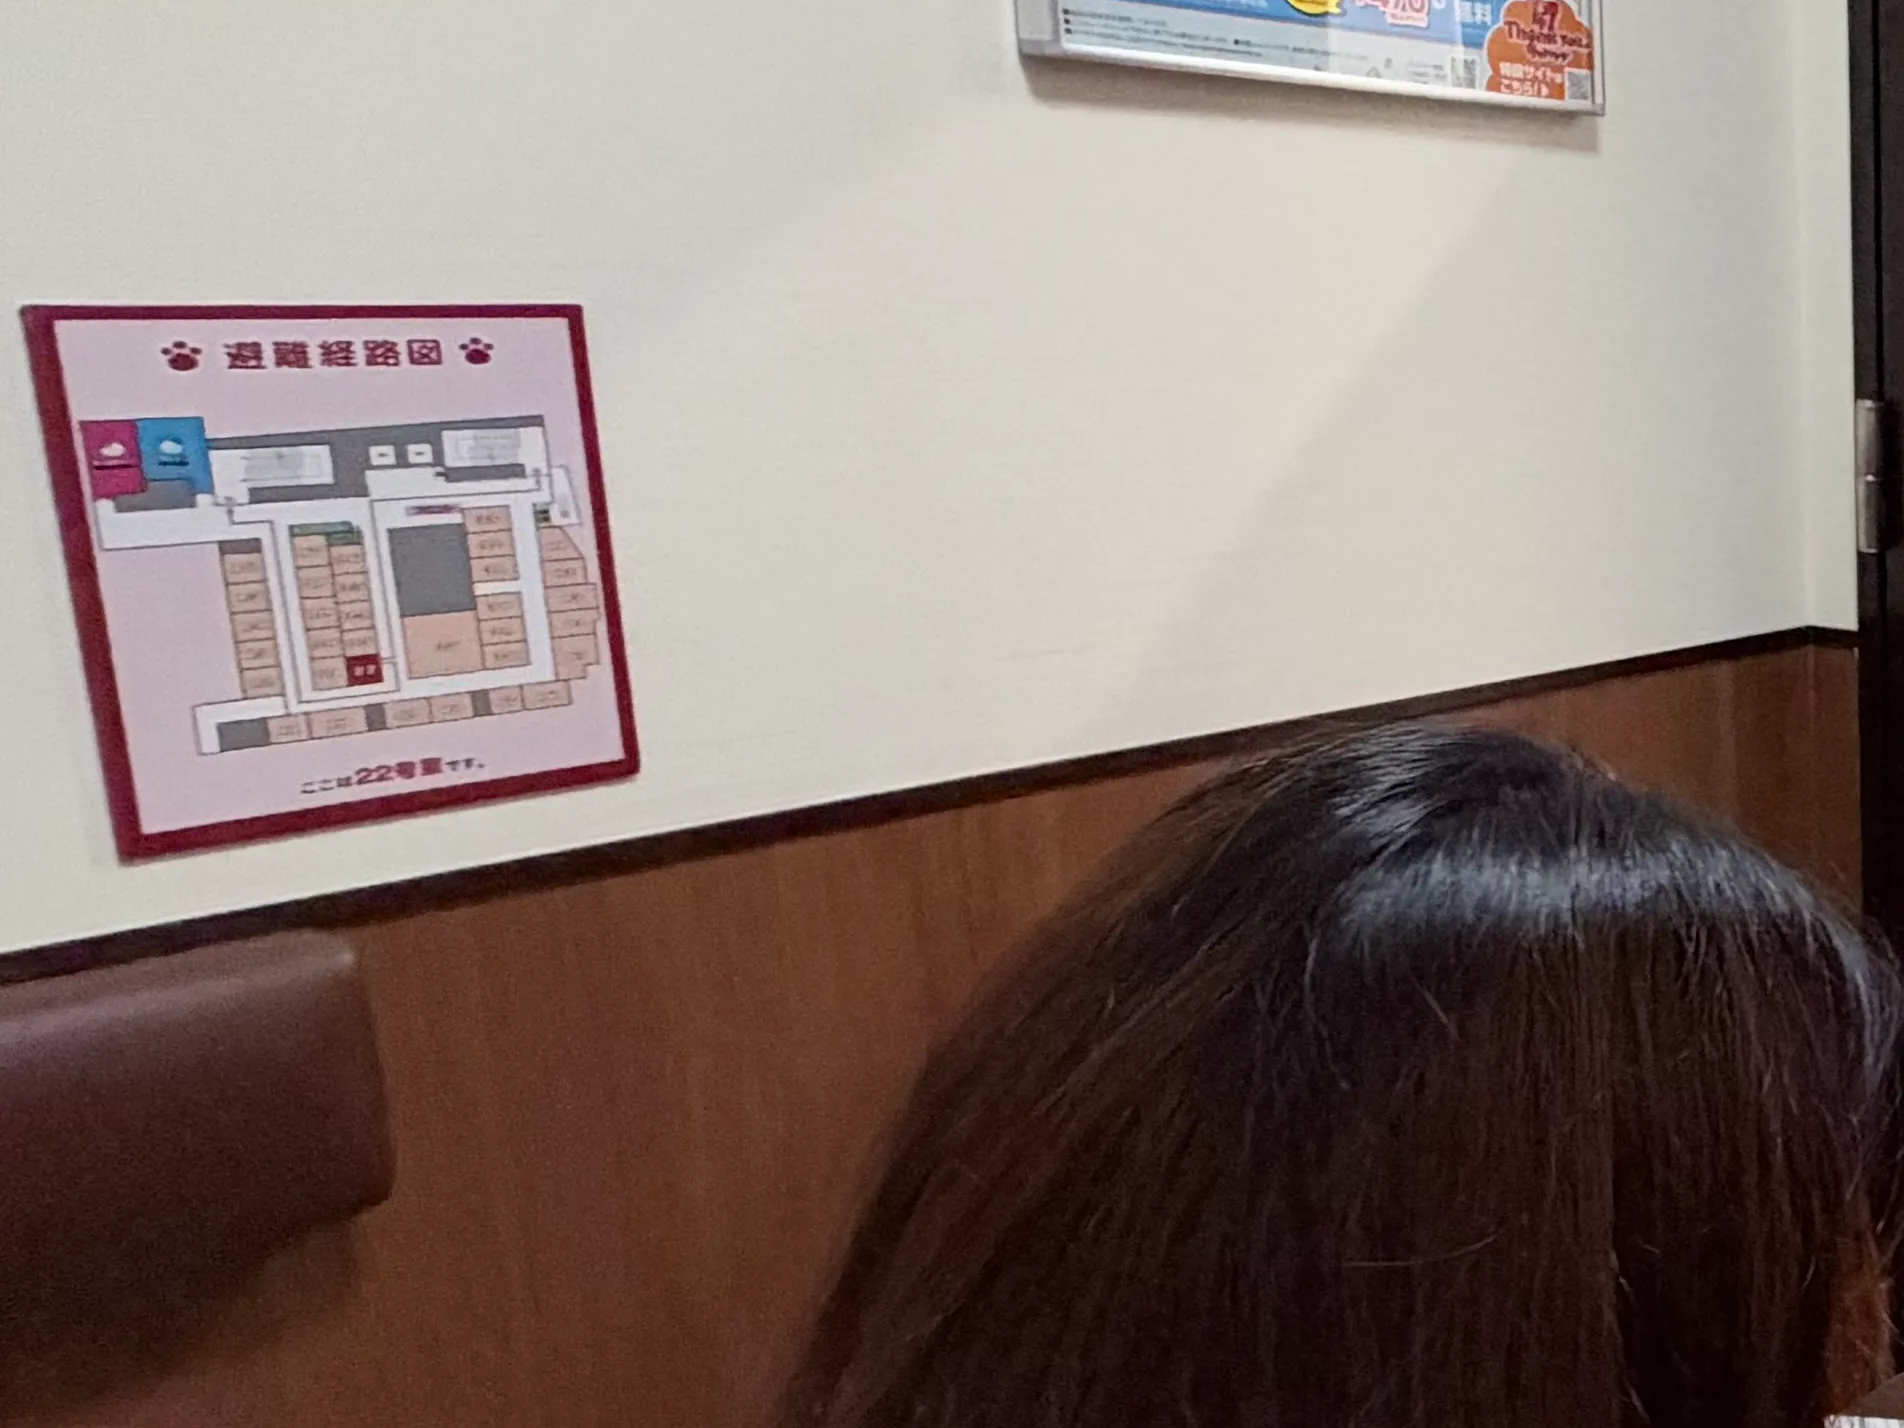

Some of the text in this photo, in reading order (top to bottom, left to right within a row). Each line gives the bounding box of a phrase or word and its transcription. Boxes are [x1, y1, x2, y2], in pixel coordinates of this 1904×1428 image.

[223, 338, 443, 370] 避難経路図
